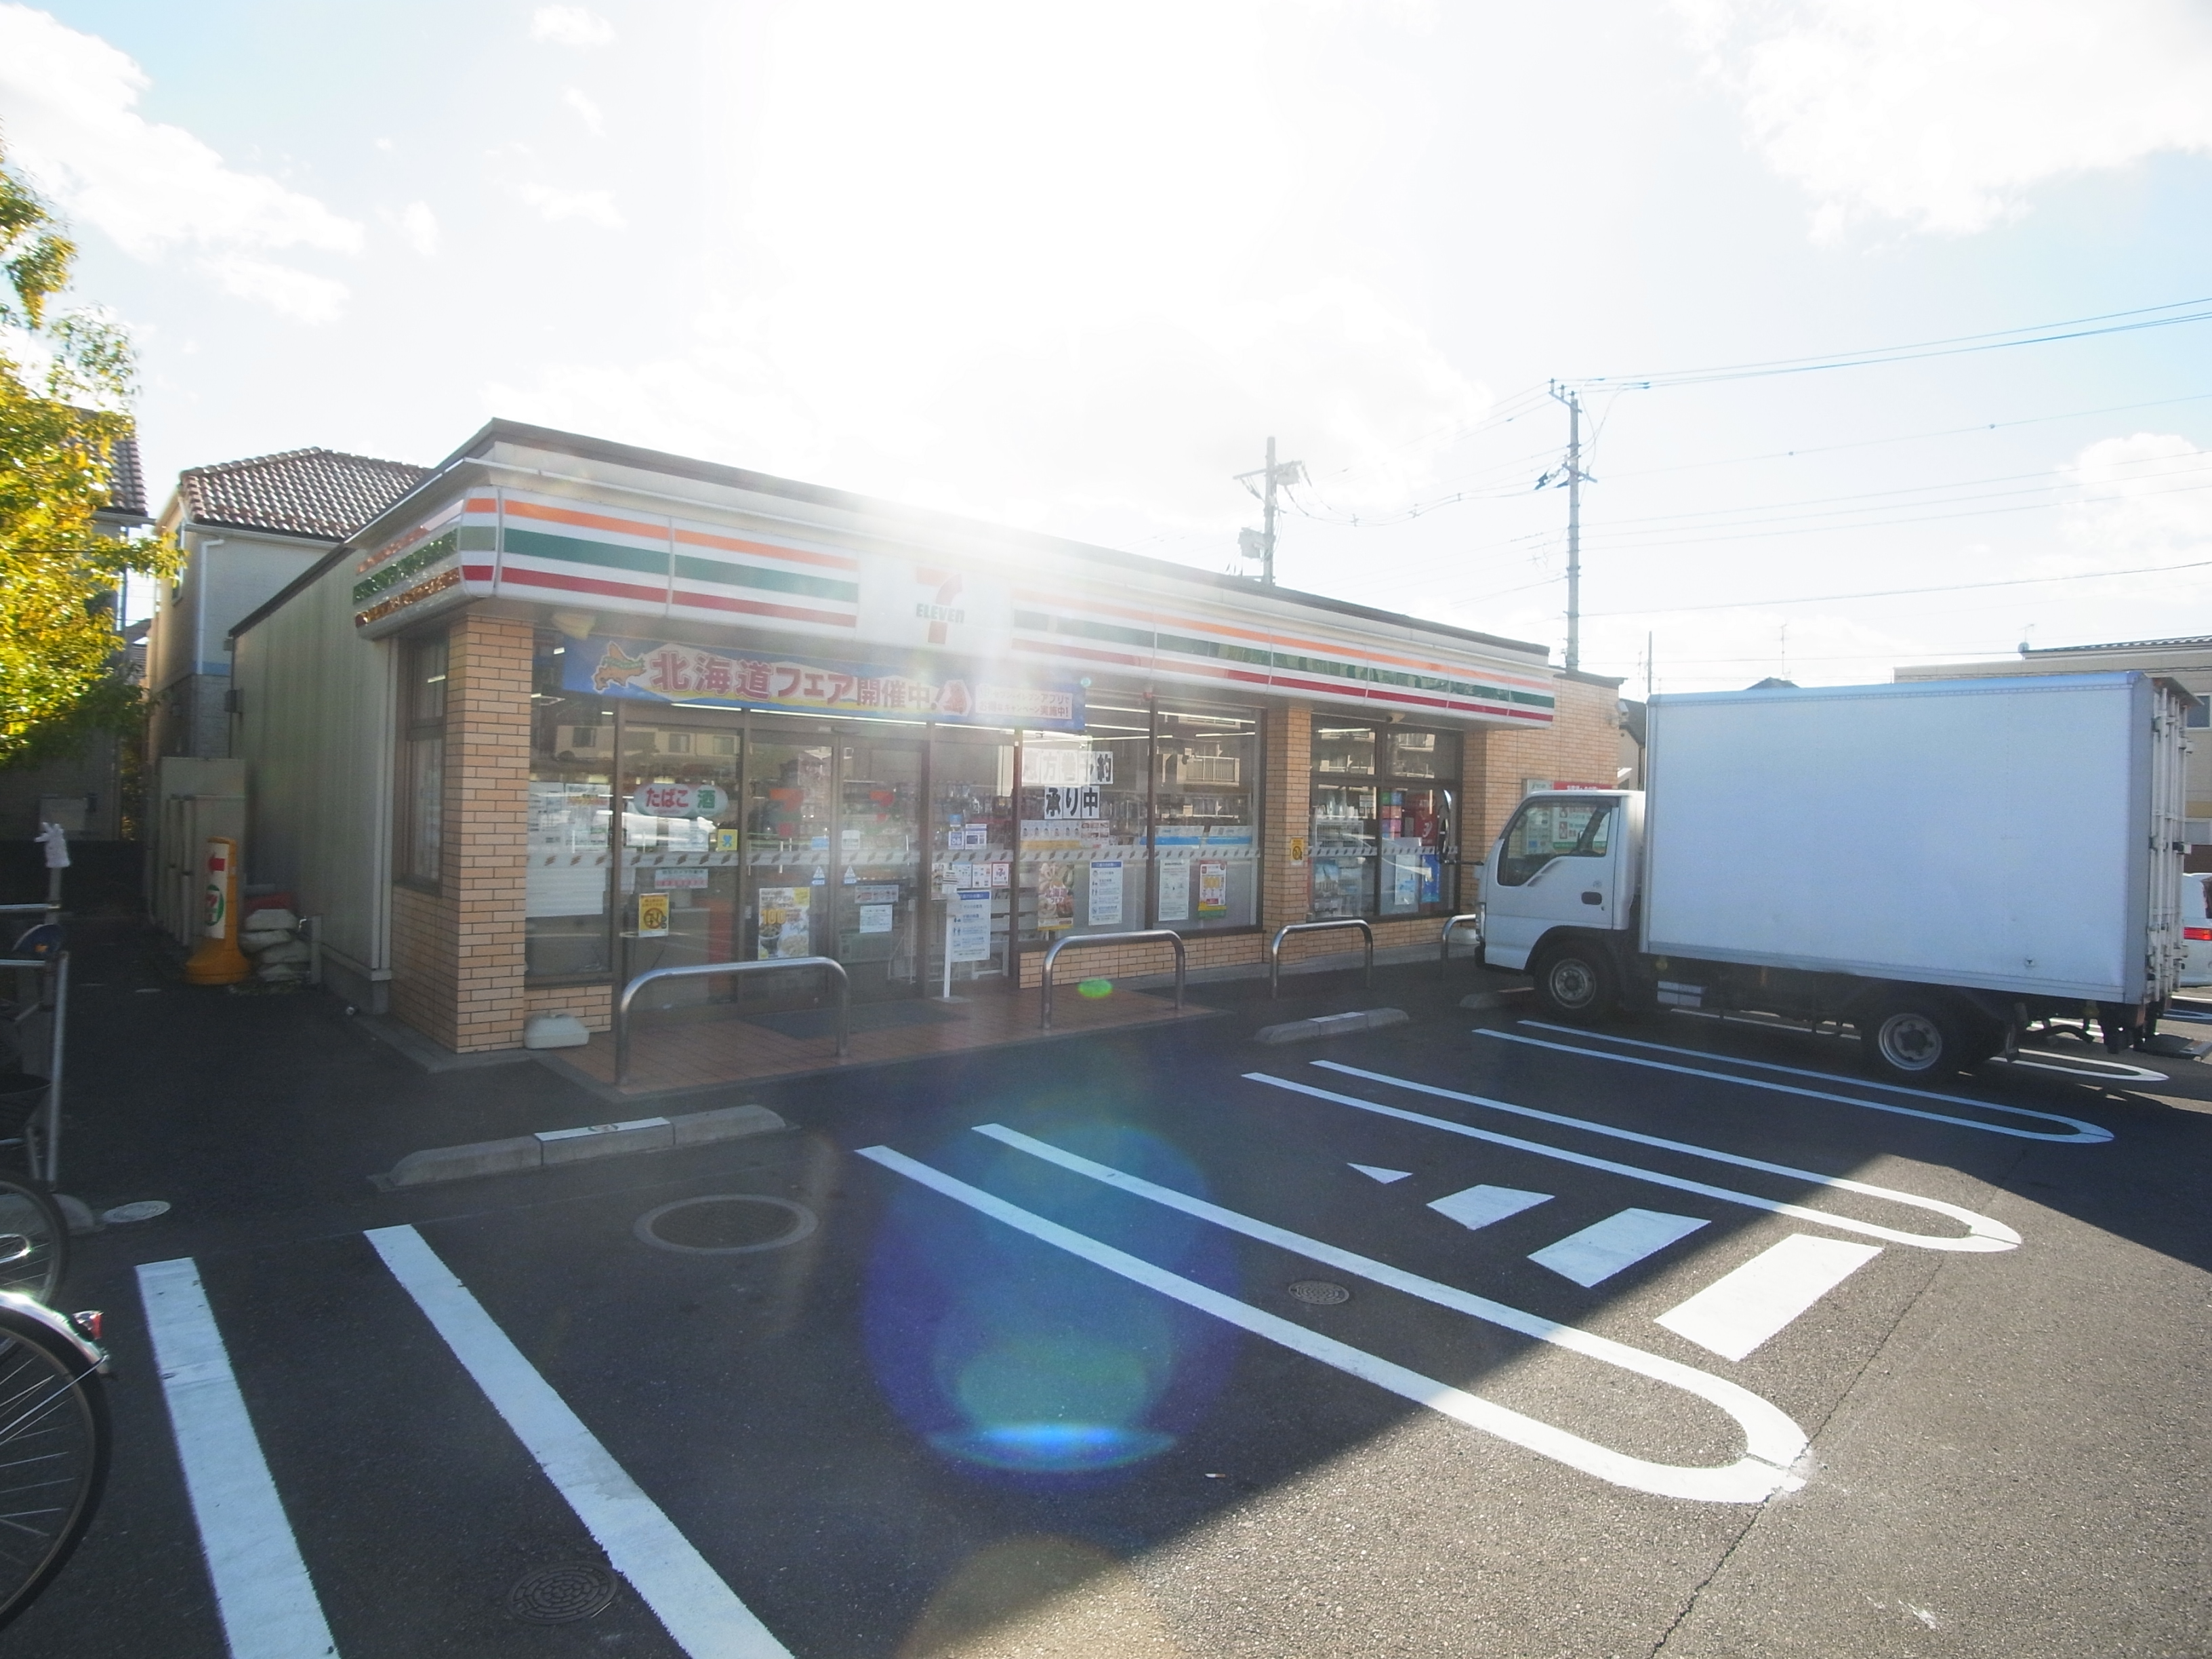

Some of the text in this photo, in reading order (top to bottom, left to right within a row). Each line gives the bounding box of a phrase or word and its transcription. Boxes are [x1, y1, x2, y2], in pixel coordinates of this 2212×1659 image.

[646, 788, 716, 808] たばこ 酒
[1046, 786, 1099, 817] 承り中
